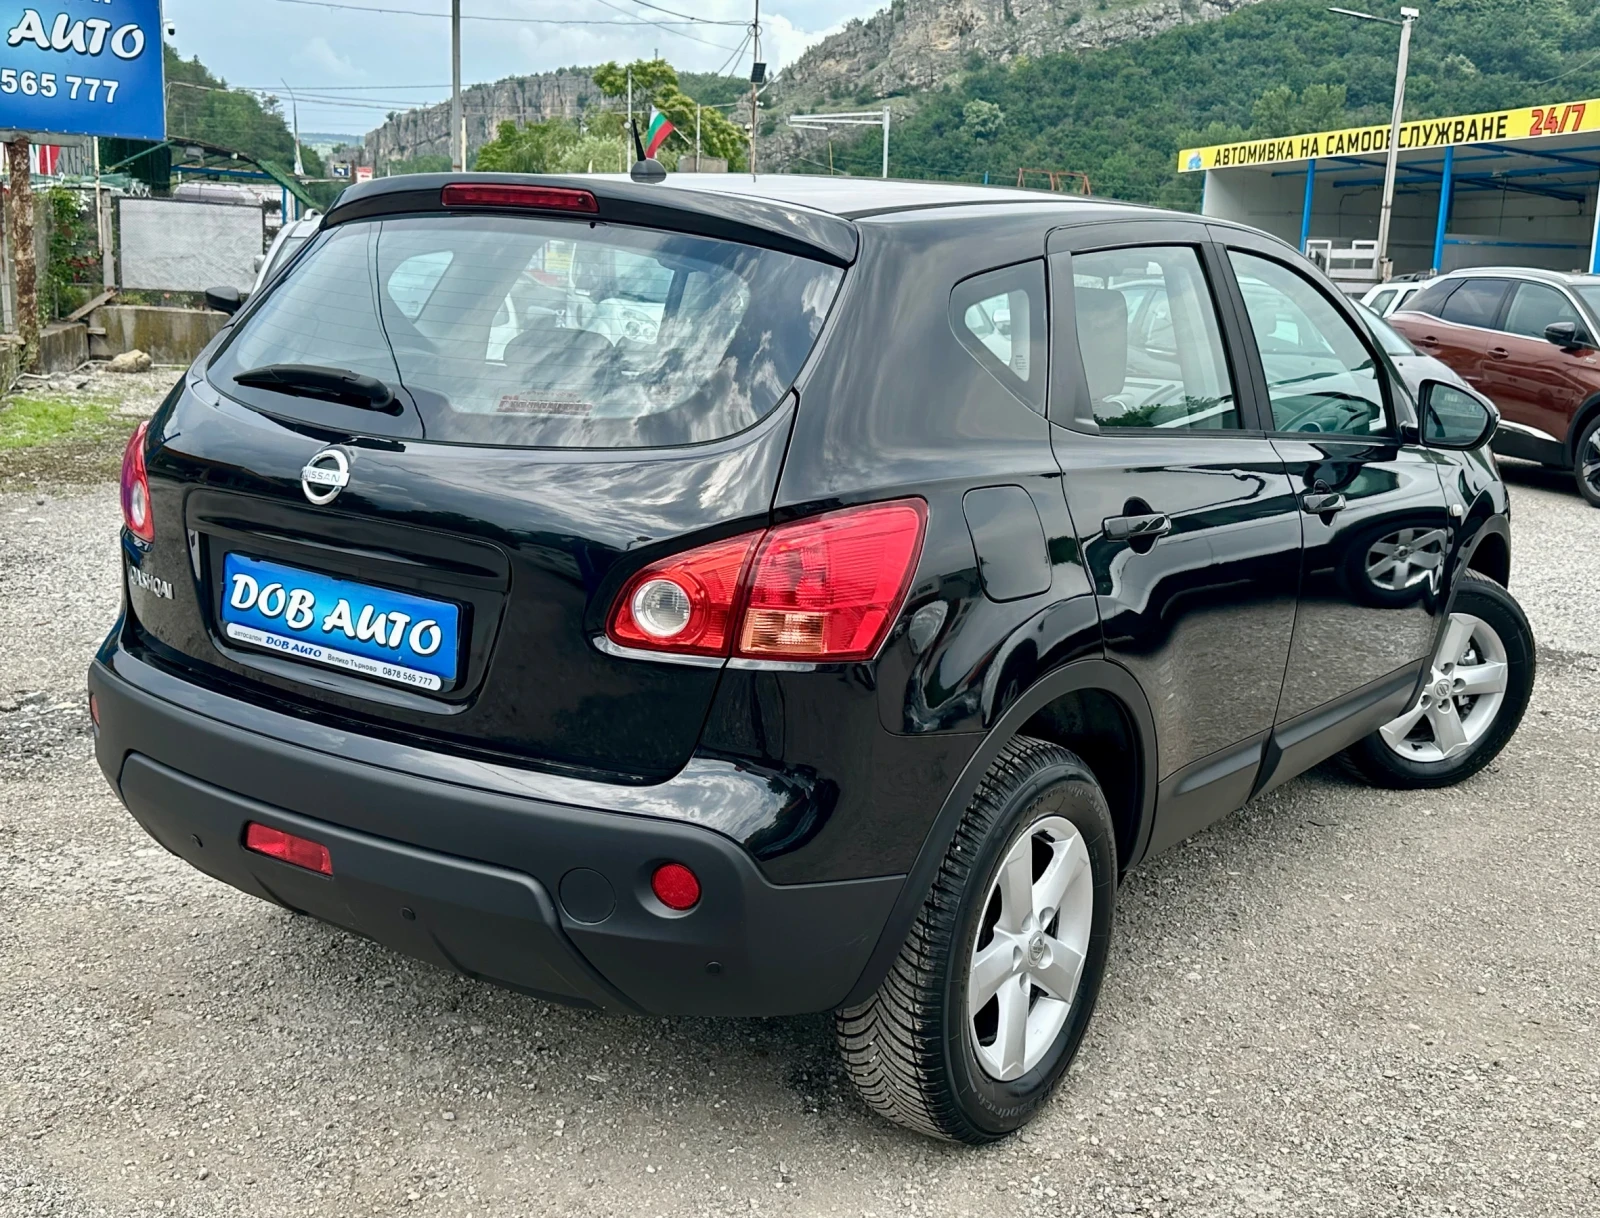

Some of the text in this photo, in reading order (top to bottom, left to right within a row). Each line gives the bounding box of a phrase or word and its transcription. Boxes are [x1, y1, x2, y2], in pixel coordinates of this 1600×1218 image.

[7, 9, 146, 60] AUTO
[0, 68, 119, 103] 565 777
[1213, 140, 1294, 167] АВТОМИВКА
[1300, 137, 1319, 157] НА
[1529, 103, 1586, 137] 24/7
[302, 469, 341, 483] NISSAN
[230, 573, 443, 657] DOB AUTO
[234, 629, 433, 686] автосалон DOB AUTO Велико Търново 0878 565 777
